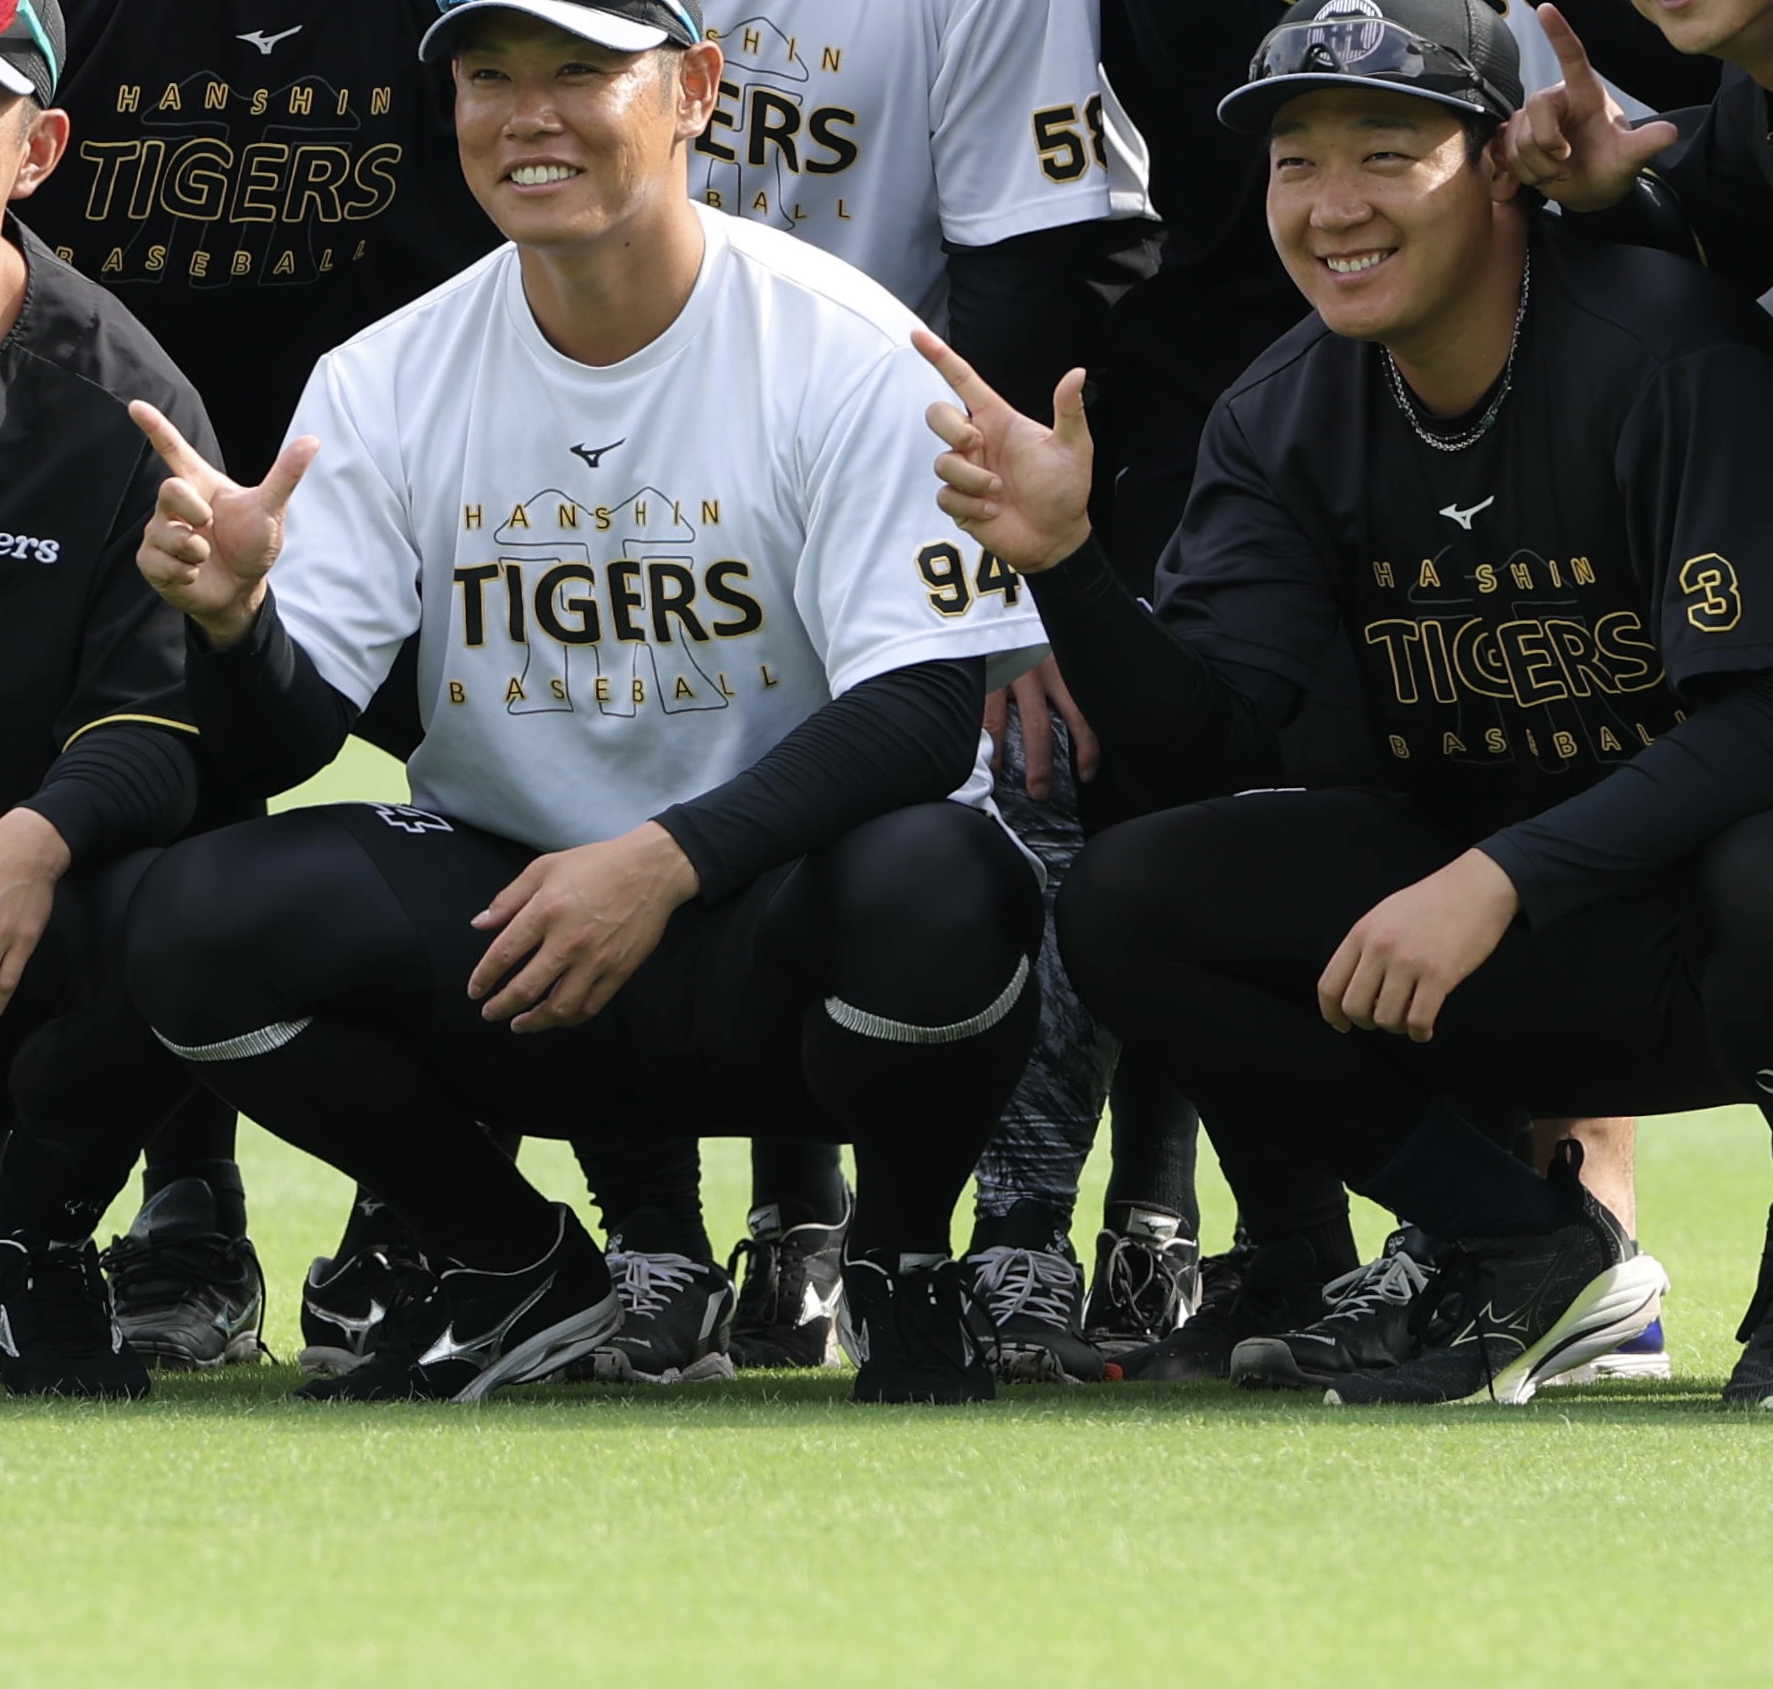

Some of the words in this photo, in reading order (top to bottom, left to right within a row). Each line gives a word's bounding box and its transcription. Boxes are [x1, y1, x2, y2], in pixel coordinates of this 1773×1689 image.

[117, 81, 391, 116] HANSHIN
[80, 137, 403, 223] TIGERS
[464, 500, 720, 531] HANSHIN
[453, 559, 764, 648] TIGERS
[915, 538, 1022, 619] 94
[1679, 552, 1742, 632] 3
[449, 665, 779, 704] BASEBALL
[1364, 611, 1666, 708] TIGERS
